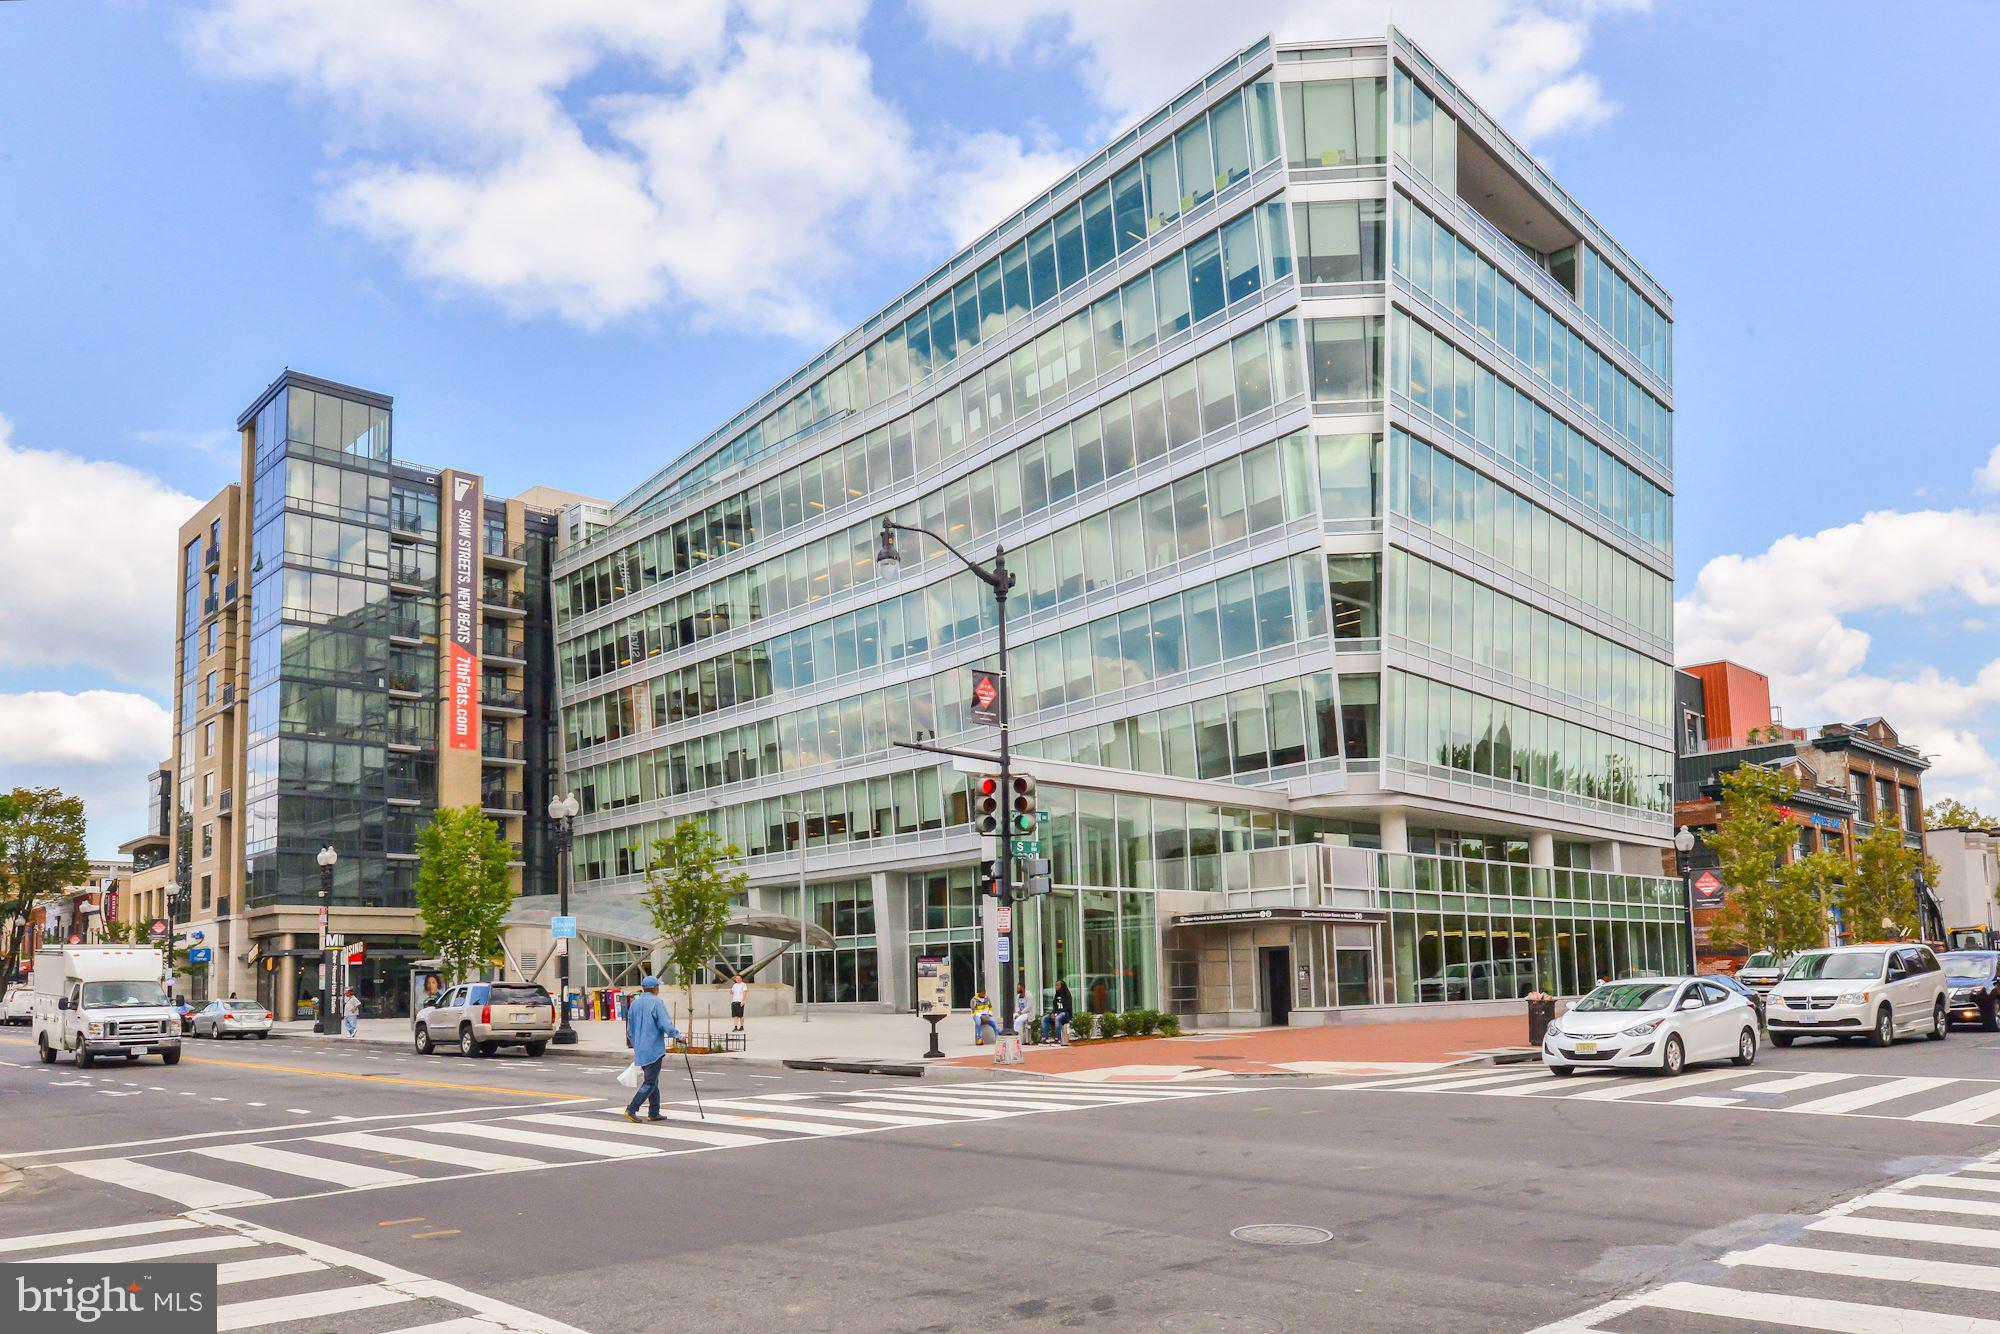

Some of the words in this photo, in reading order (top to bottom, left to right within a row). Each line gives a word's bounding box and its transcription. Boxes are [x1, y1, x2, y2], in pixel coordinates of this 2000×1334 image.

[458, 508, 471, 538] SHAW
[457, 539, 471, 585] STREETS,
[457, 589, 471, 611] NEW
[457, 612, 471, 644] BEATS
[456, 656, 471, 736] 7thFlats.com
[1016, 841, 1024, 852] S
[326, 934, 338, 947] M
